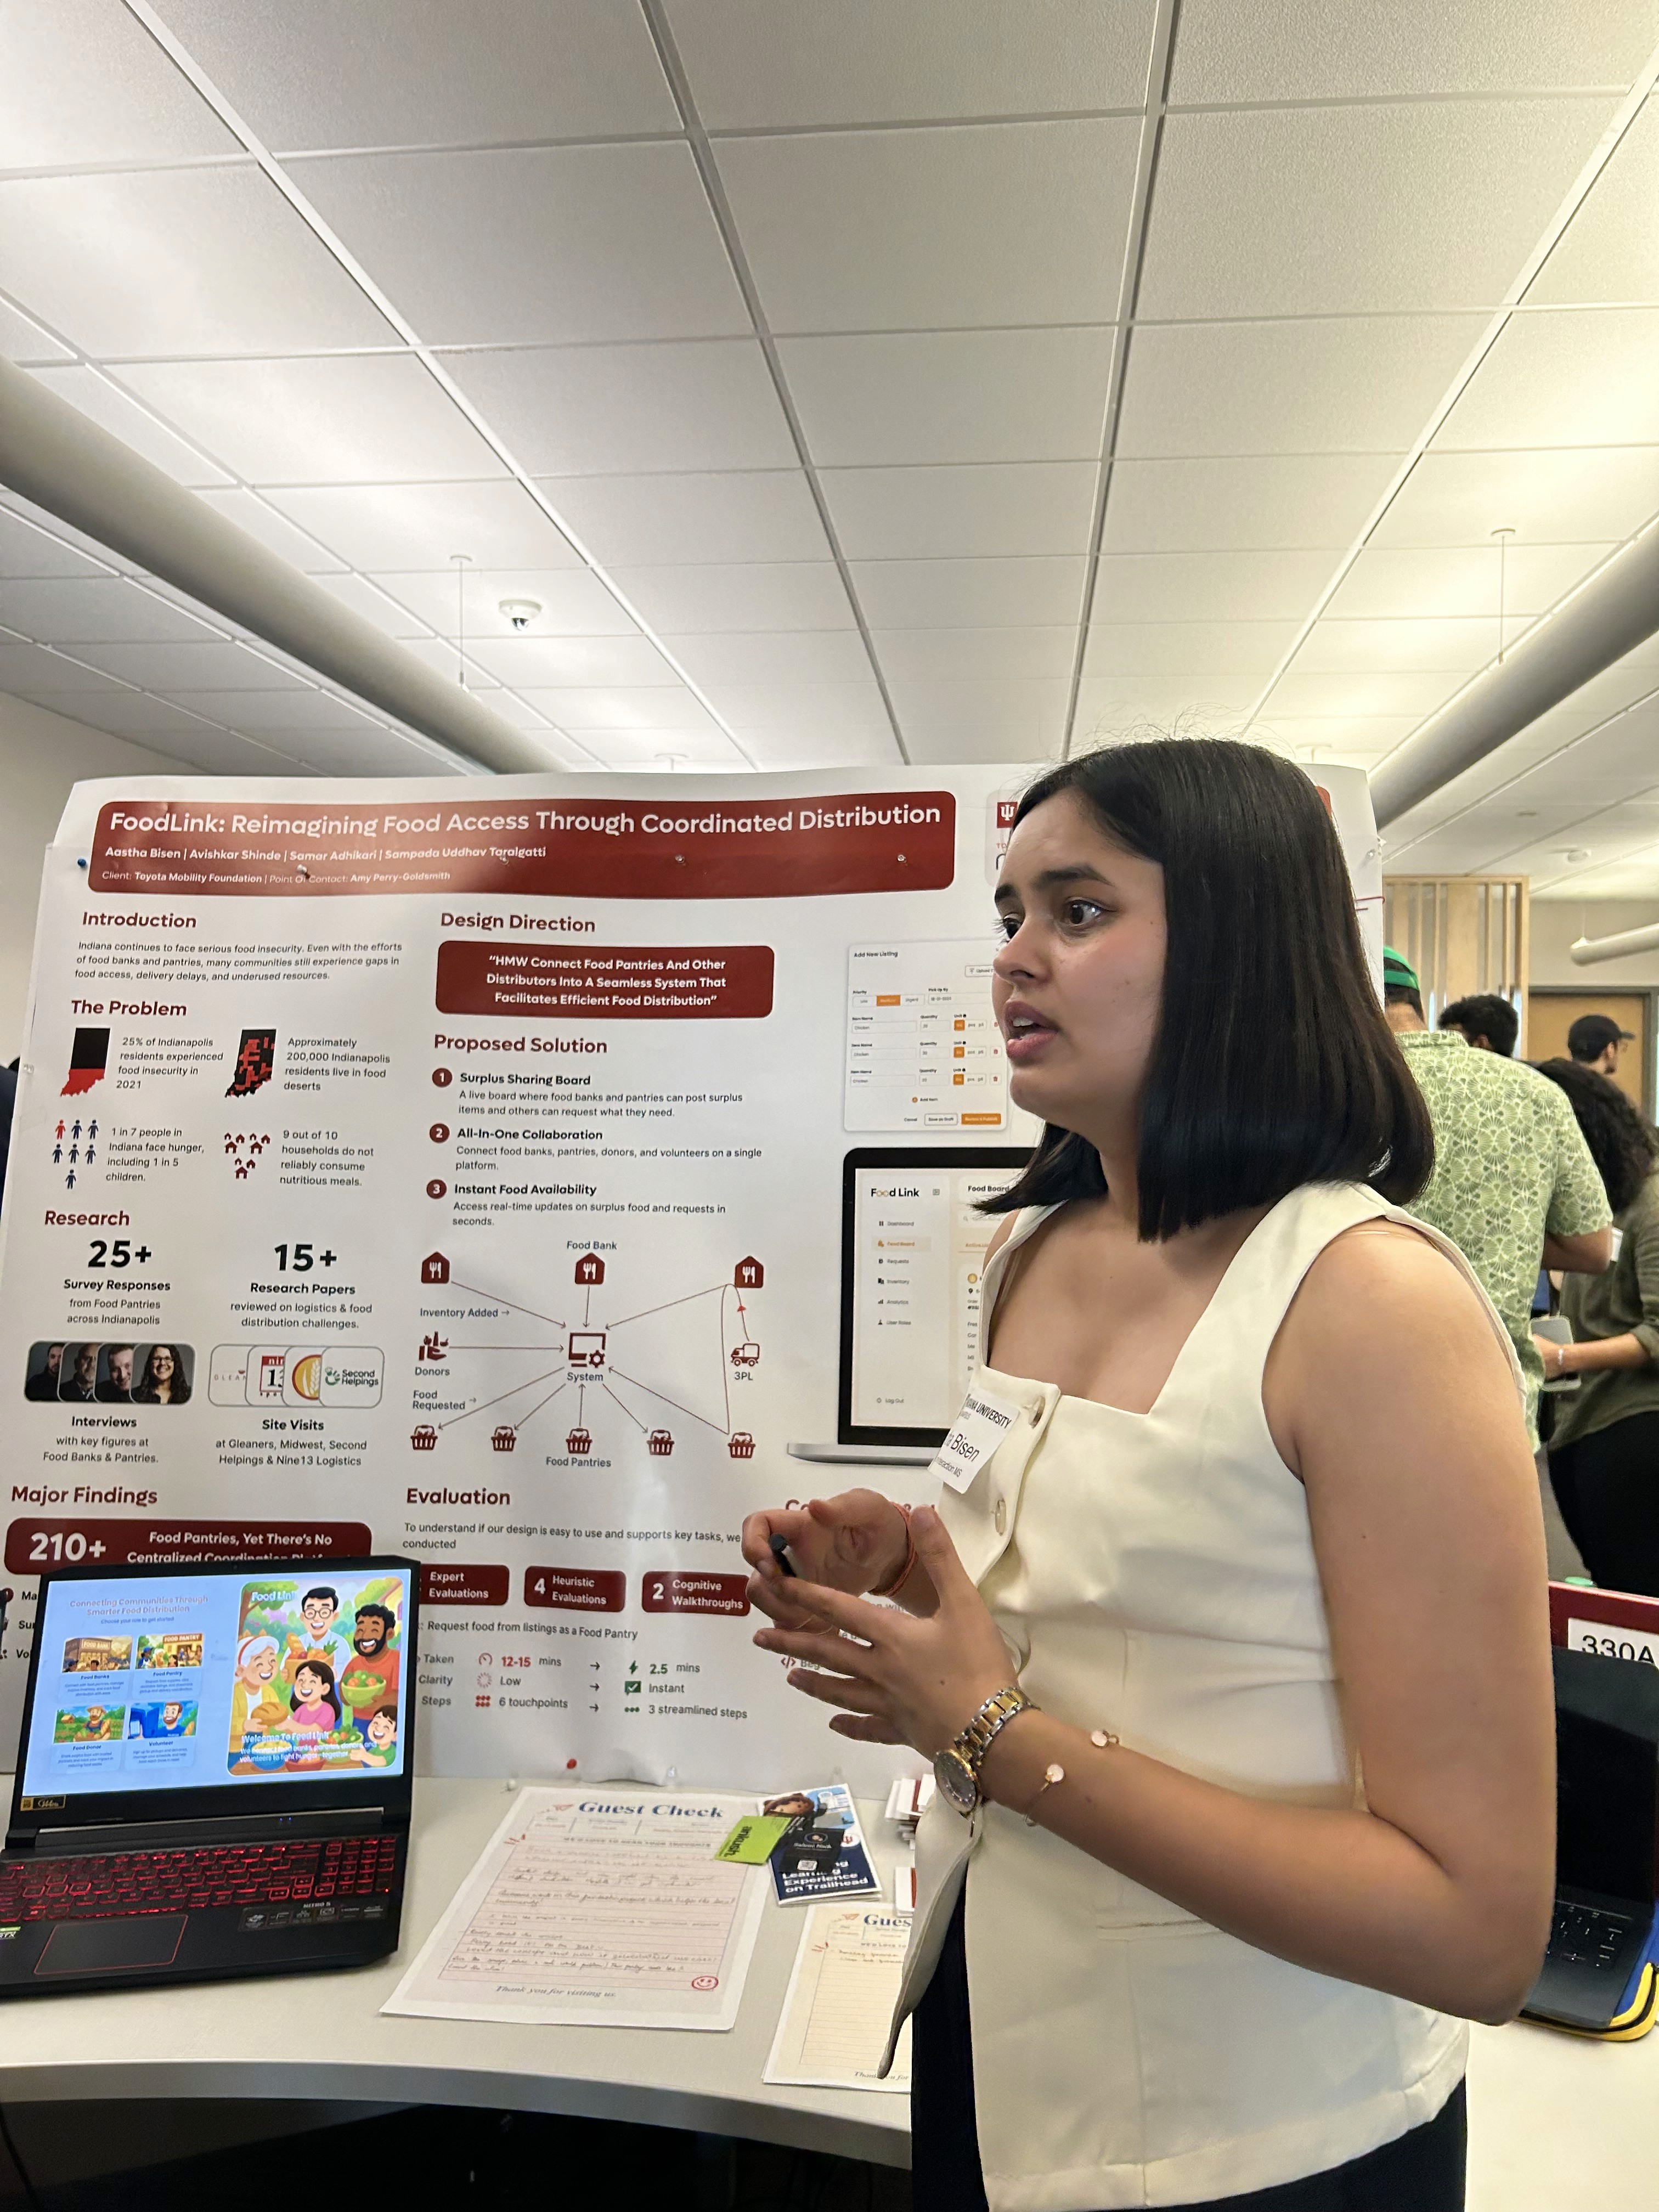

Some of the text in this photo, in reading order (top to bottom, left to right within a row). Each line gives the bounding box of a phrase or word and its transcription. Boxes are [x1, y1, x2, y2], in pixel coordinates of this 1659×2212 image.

[110, 804, 940, 838] FoodLink: Reimagining Food Access Through Coordinated Distribution
[105, 846, 546, 860] Aastha Bisen Avishkar Shinde Samar Adhikari Sampada Uddhav Taralgatti
[102, 871, 131, 879] Client:
[134, 871, 166, 882] Toyota
[168, 872, 206, 883] Mobility
[208, 873, 262, 882] Foundation
[309, 874, 348, 883] Contact:
[350, 874, 371, 883] Amy
[82, 912, 196, 928] Introduction
[441, 912, 595, 932] Design Direction
[531, 957, 581, 969] Connect
[584, 959, 613, 969] Food
[616, 959, 663, 969] Pantries
[666, 960, 689, 969] And
[692, 959, 725, 969] Other
[487, 973, 726, 990] Distributors Into A Seamless System That
[495, 992, 557, 1004] Facilitates
[560, 994, 609, 1005] Efficient
[612, 995, 641, 1005] Food
[71, 1000, 186, 1015] The Problem
[122, 1037, 213, 1048] 25% of Indianapolis
[435, 1034, 607, 1053] Proposed Solution
[120, 1051, 223, 1062] residents experienced
[118, 1065, 198, 1076] food insecurity in
[116, 1080, 140, 1088] 2021
[439, 1073, 590, 1086] 1 Surplus Sharing Board
[435, 1127, 602, 1139] 2 All-In-One Collaboration
[432, 1184, 596, 1197] 3 Instant Food Availability
[871, 1187, 919, 1197] Food Link
[44, 1210, 129, 1225] Research
[567, 1240, 617, 1250] Food Bank
[88, 1240, 151, 1267] 25+
[274, 1244, 336, 1271] 15+
[64, 1279, 170, 1291] Survey Responses
[250, 1282, 355, 1296] Research Papers
[420, 1308, 498, 1319] Inventory Added
[342, 1369, 375, 1378] Second
[414, 1366, 449, 1375] Donors
[734, 1371, 753, 1380] 3PL
[341, 1377, 379, 1386] Helpings
[567, 1372, 603, 1383] System
[413, 1390, 437, 1399] Food
[412, 1400, 465, 1410] Requested
[72, 1415, 137, 1427] Interviews
[976, 1402, 1012, 1429] UNIVERSITY
[262, 1418, 324, 1430] Site Visits
[950, 1433, 980, 1462] Bisen
[546, 1456, 611, 1467] Food Pantries
[953, 1466, 963, 1477] MS
[12, 1485, 157, 1507] Major Findings
[407, 1487, 510, 1505] Evaluation
[149, 1531, 180, 1543] Food
[184, 1532, 239, 1545] Pantries,
[243, 1533, 263, 1544] Yet
[314, 1534, 332, 1545] No
[29, 1532, 106, 1561] 210+
[430, 1571, 464, 1583] Expert
[552, 1575, 594, 1587] Heuristic
[534, 1578, 545, 1594] 4
[652, 1583, 663, 1599] 2
[672, 1579, 721, 1591] Cognitive
[429, 1588, 488, 1598] Evaluations
[552, 1591, 606, 1604] Evaluations
[70, 1595, 208, 1607] Connecting Communities Through
[672, 1595, 743, 1610] Walkthroughs
[143, 1605, 190, 1613] Distribution
[1582, 1635, 1655, 1663] 330A
[501, 1656, 561, 1667] 12-15 mins
[650, 1662, 700, 1674] 2.5 mins
[648, 1683, 684, 1693] Instant
[499, 1697, 568, 1709] 6 touchpoints
[648, 1705, 747, 1719] 3 streamlined steps
[579, 1802, 722, 1818] Guest Check
[784, 1872, 858, 1886] Experience
[806, 1876, 869, 1891] Trailhead
[864, 1914, 912, 1927] Gues
[567, 1989, 602, 1997] visiting
